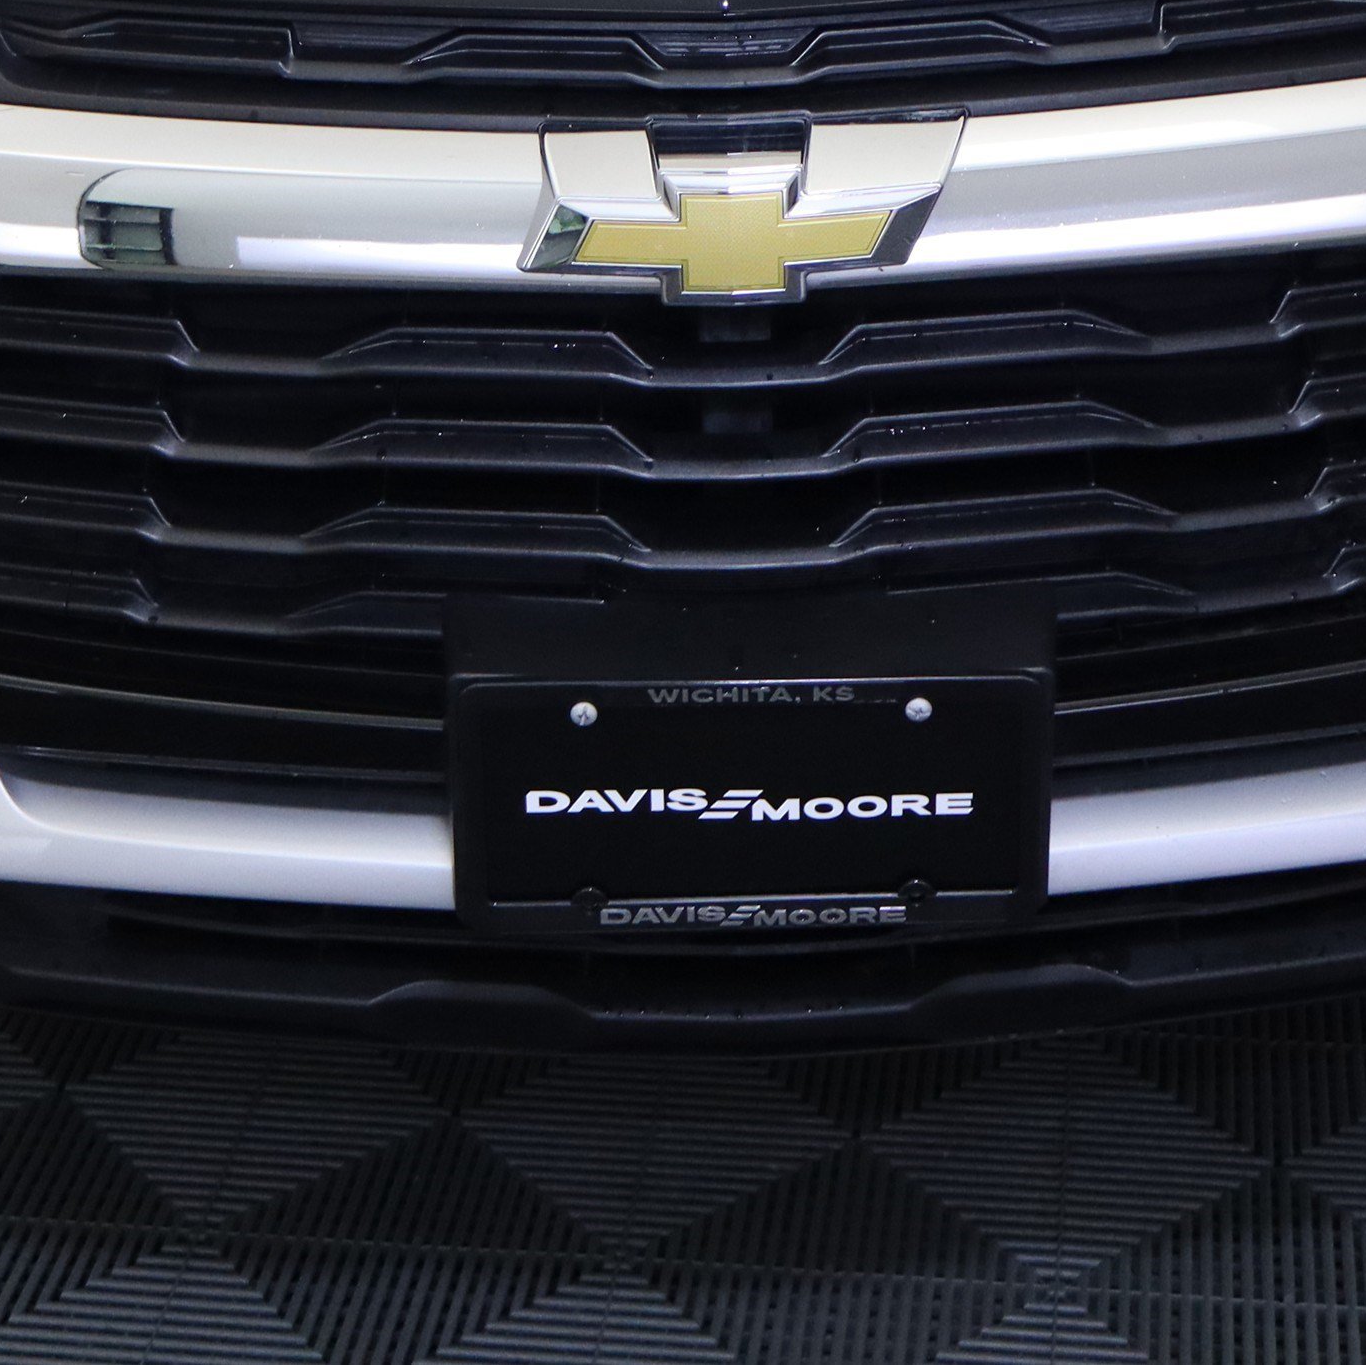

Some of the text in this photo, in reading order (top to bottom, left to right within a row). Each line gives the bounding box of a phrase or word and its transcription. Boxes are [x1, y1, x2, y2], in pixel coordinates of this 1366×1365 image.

[647, 685, 855, 704] WICHITA, KS
[525, 788, 974, 821] DAVIS MOORE
[600, 905, 907, 926] DAVIS MOORE
